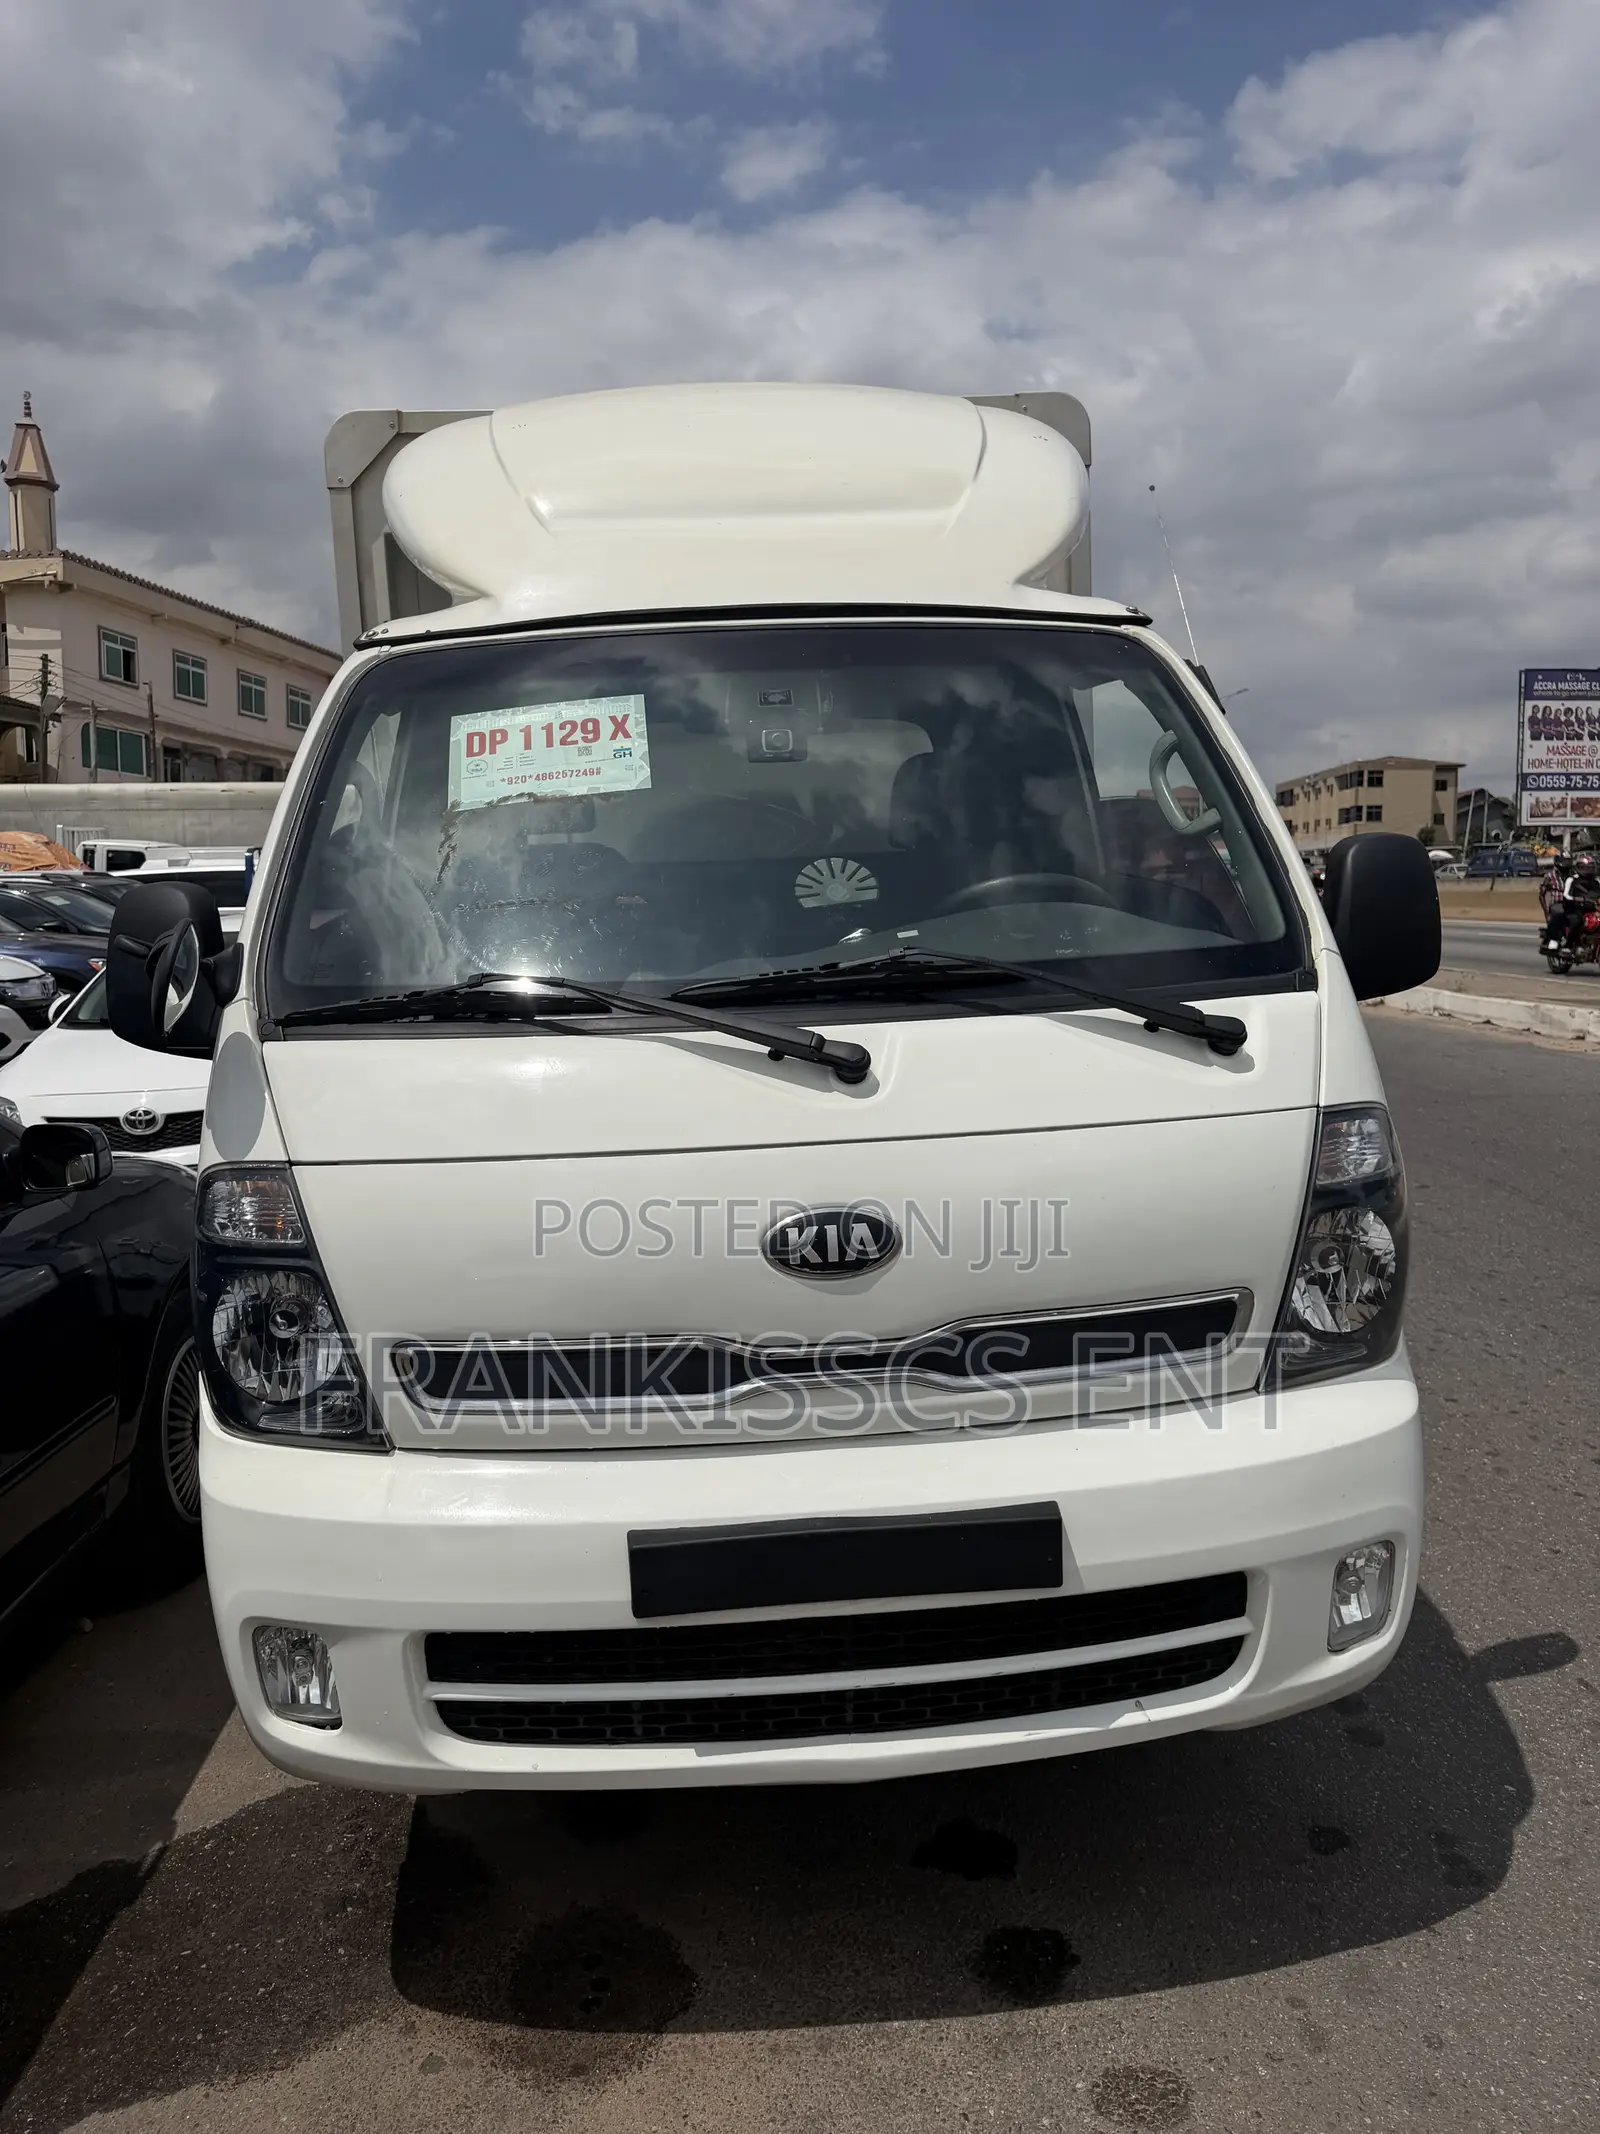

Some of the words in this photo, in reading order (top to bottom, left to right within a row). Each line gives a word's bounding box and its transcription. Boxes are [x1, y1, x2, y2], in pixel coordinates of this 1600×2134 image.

[1533, 681, 1557, 691] ACCRA
[1558, 682, 1590, 691] MASSAGE
[466, 728, 509, 758] DP
[519, 717, 601, 751] 1129
[608, 713, 632, 741] X
[613, 751, 633, 759] GH
[1546, 745, 1587, 756] MASSAGE
[786, 1222, 880, 1265] KIA
